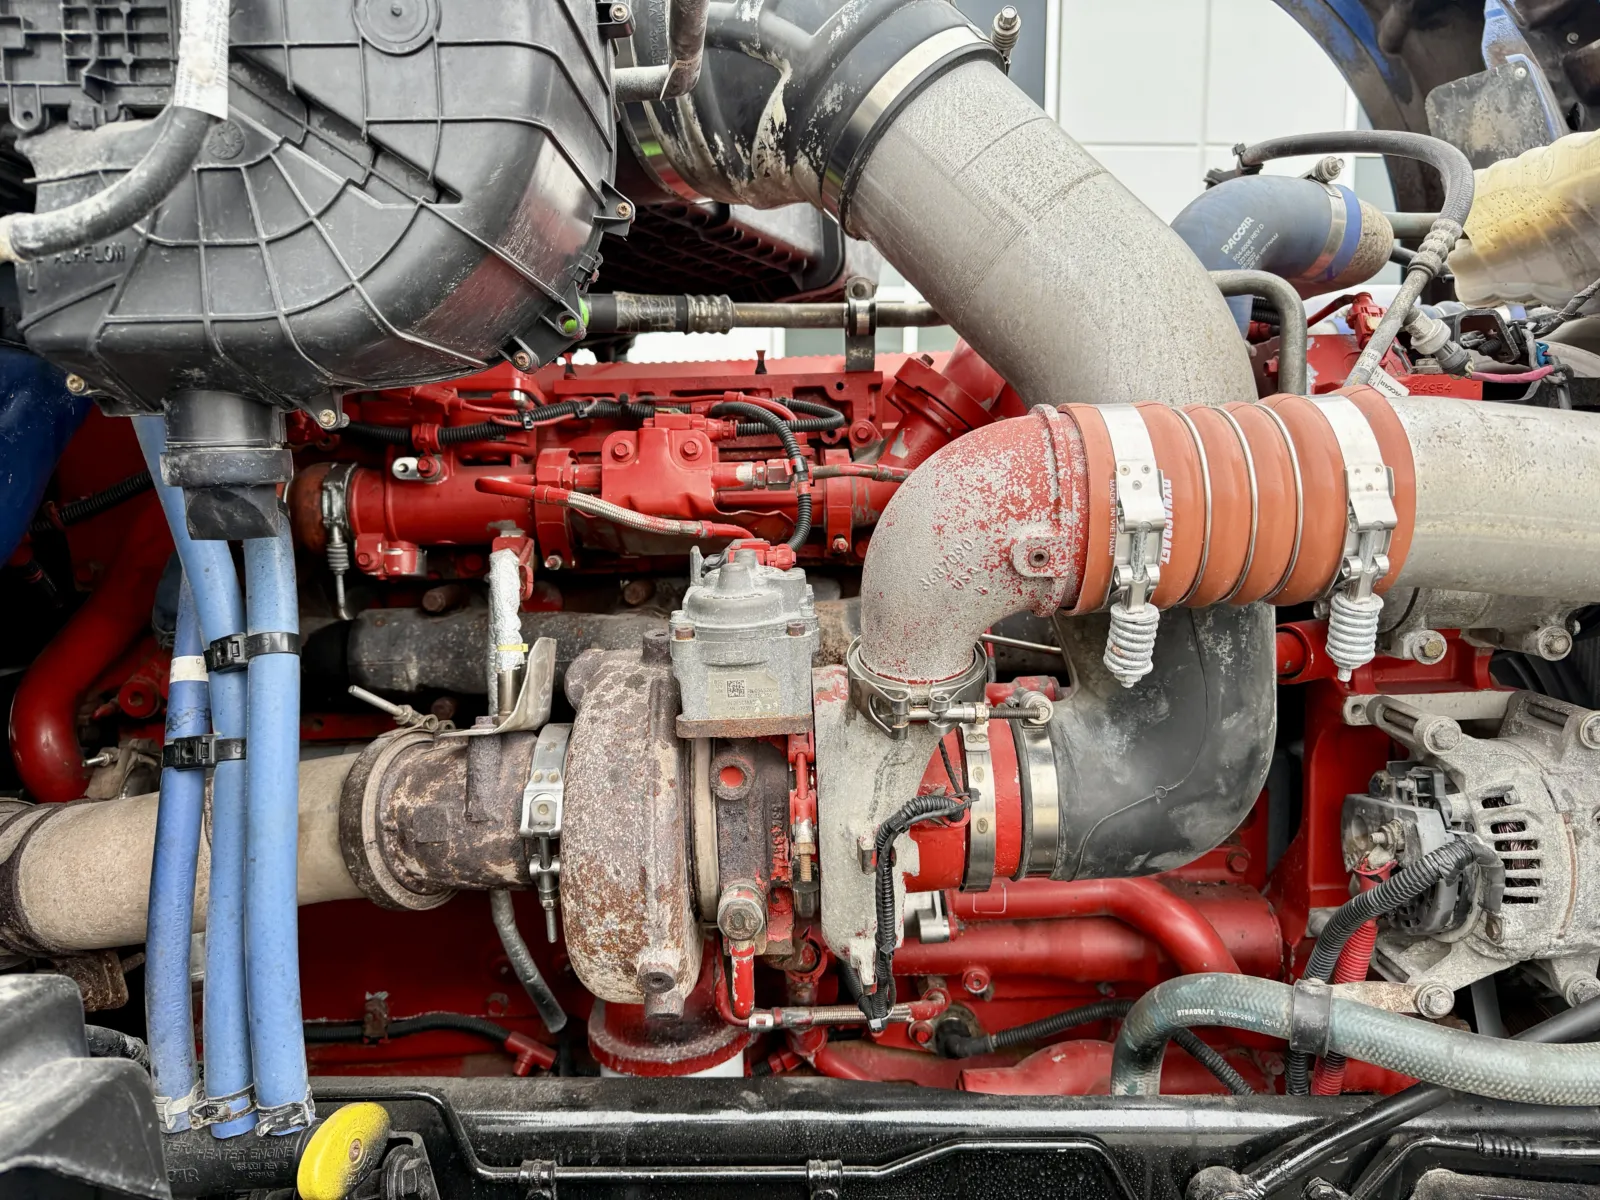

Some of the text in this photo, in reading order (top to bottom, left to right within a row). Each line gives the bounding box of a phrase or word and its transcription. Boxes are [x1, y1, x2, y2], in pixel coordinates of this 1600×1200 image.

[1220, 216, 1255, 255] PACCAR
[1249, 227, 1262, 241] REV
[1258, 232, 1280, 256] VIETNAM
[1380, 379, 1404, 398] ACCAR
[1108, 479, 1117, 556] MADE IN VIETNAM
[920, 536, 975, 591] 3687090
[950, 564, 980, 592] USA
[196, 1147, 246, 1161] HEATER
[250, 1146, 295, 1160] ENGINE
